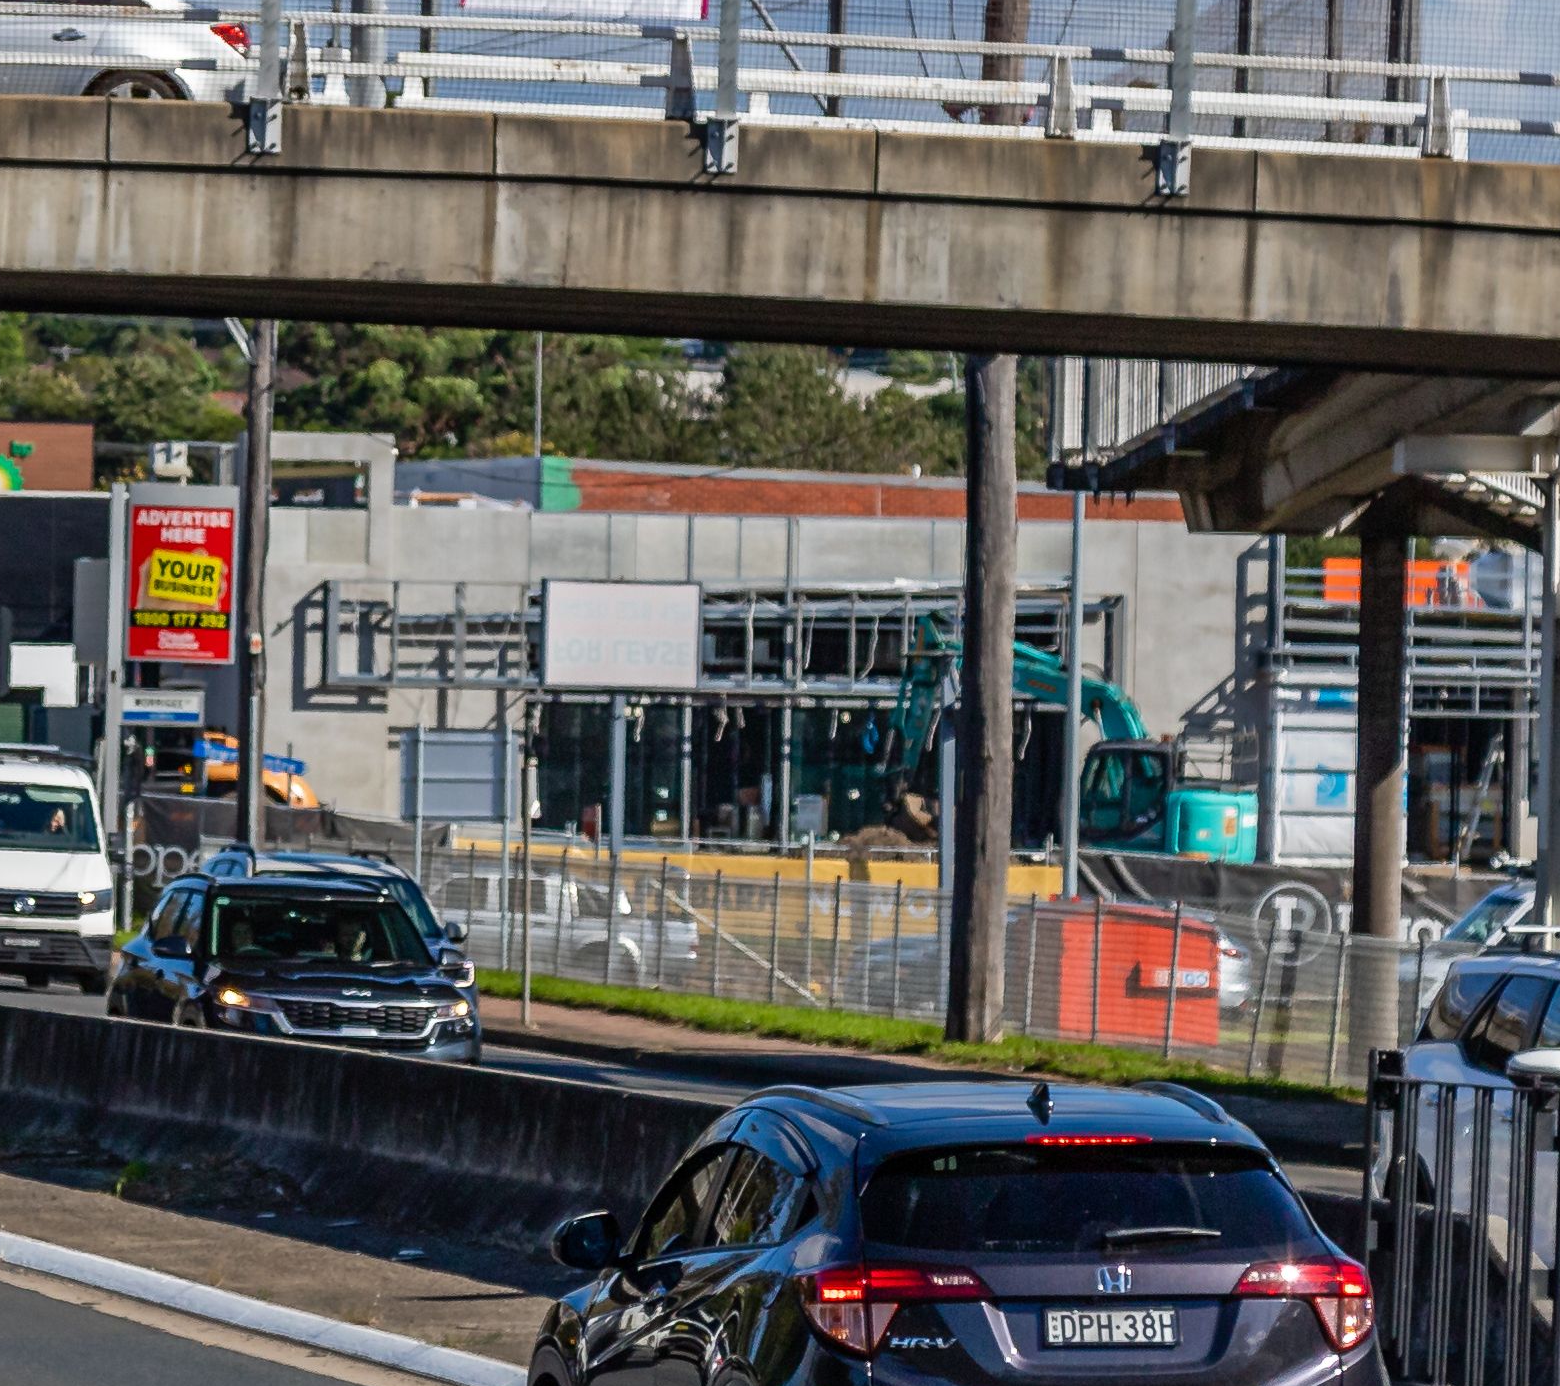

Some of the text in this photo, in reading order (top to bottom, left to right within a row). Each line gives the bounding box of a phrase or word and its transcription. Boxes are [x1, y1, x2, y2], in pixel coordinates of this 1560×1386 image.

[137, 509, 231, 528] ADVERTISE
[160, 528, 207, 544] HERE
[158, 558, 216, 582] YOUR
[889, 1337, 958, 1349] HR-V
